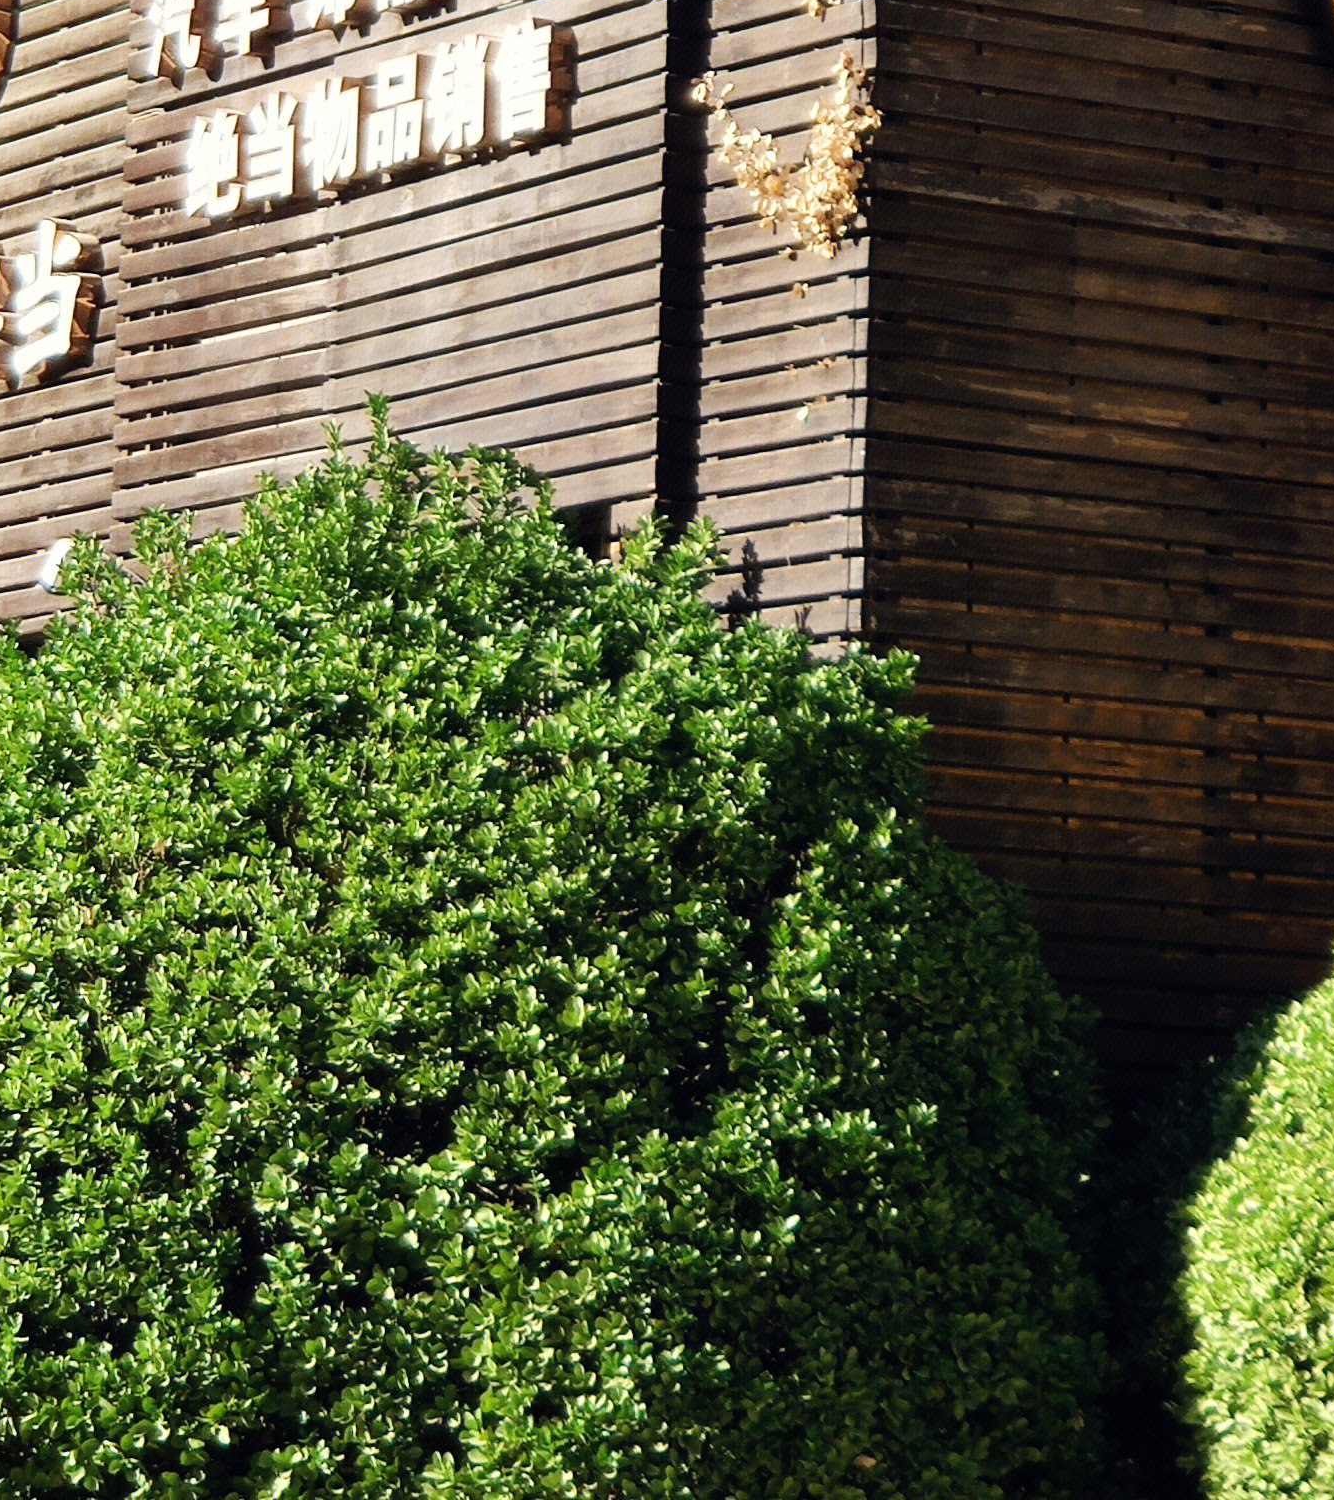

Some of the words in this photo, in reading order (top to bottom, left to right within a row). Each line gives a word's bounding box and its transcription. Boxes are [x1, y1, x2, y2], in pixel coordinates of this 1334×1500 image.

[184, 15, 552, 218] 绝当物品销售
